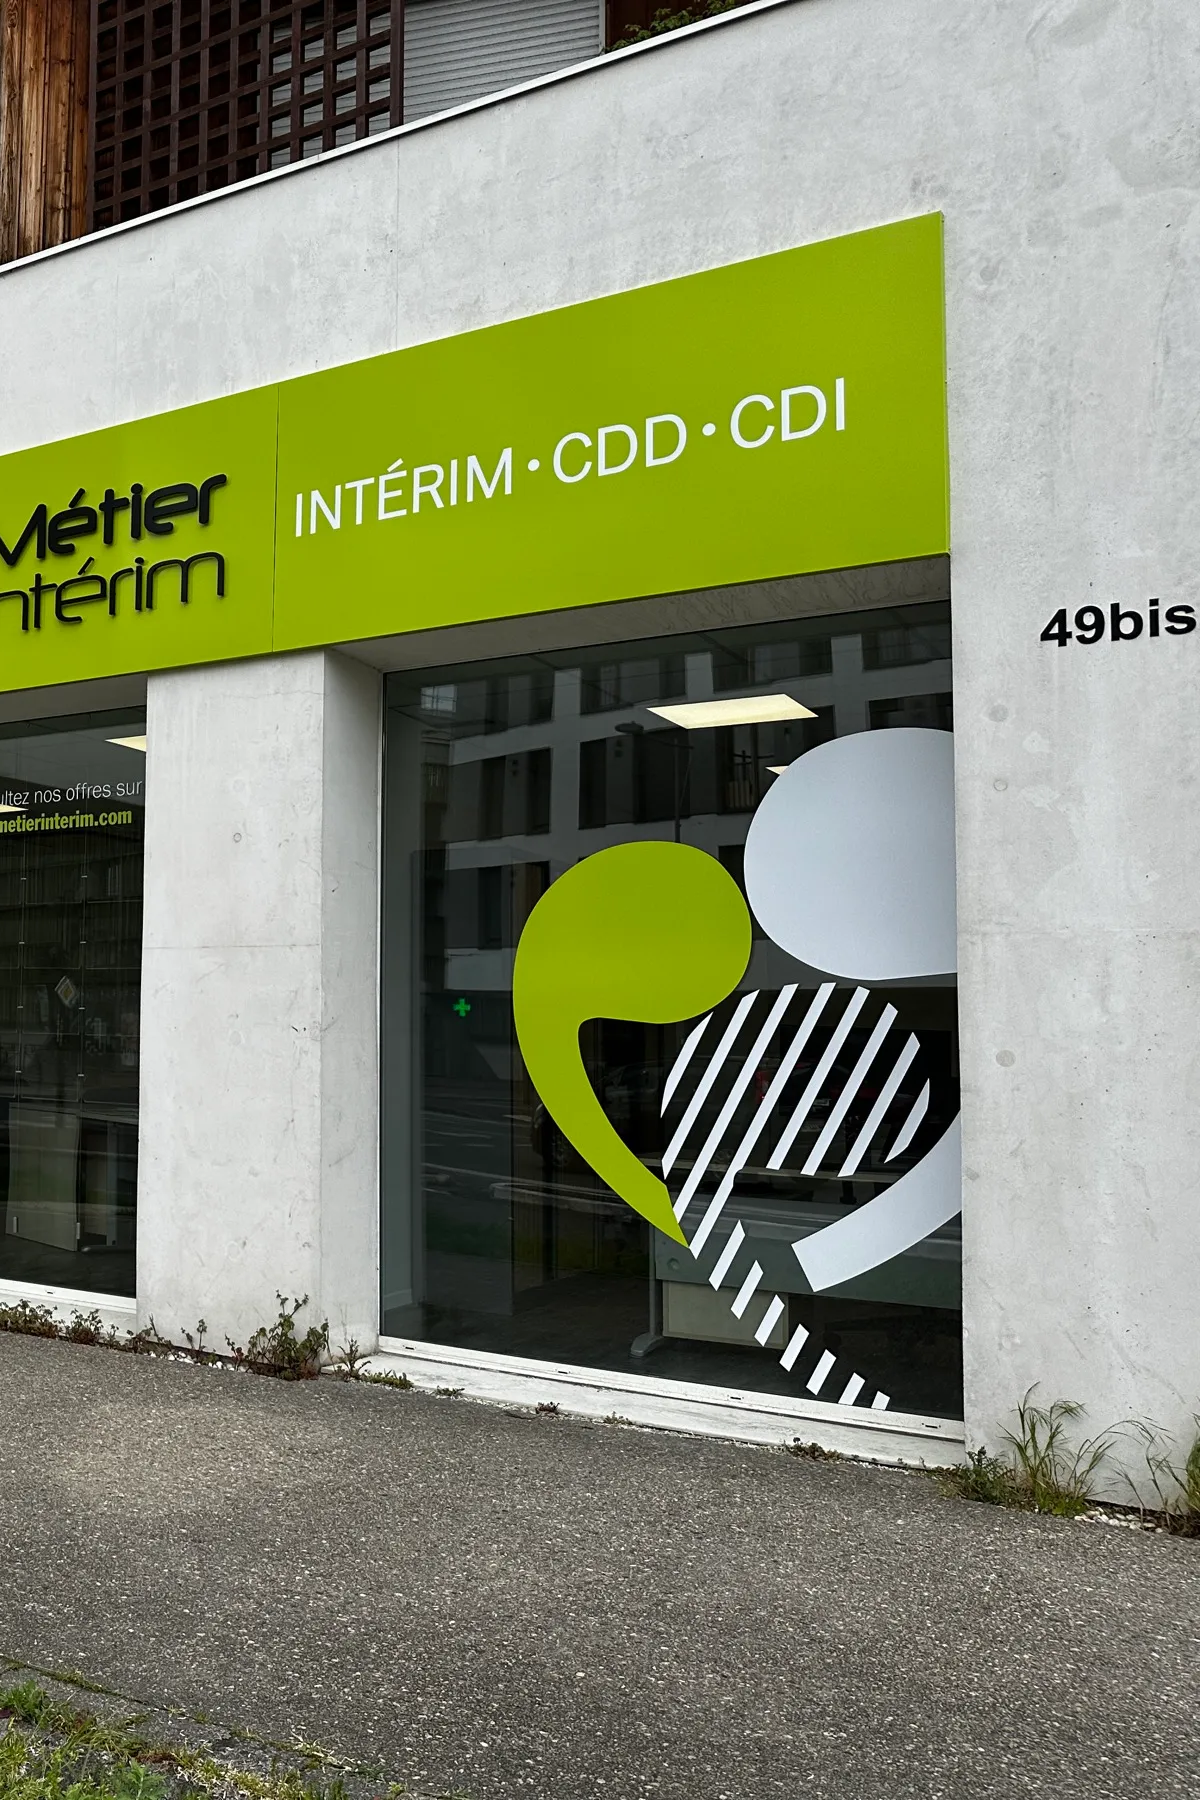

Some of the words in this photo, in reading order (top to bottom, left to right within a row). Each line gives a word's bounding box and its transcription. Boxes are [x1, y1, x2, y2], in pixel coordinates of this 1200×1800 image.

[294, 459, 513, 538] INTÉRIM
[553, 413, 688, 485] CDD
[730, 377, 846, 449] CDI
[1039, 597, 1197, 648] 49bis
[34, 788, 62, 804] nos
[65, 782, 112, 802] offres
[116, 780, 143, 797] sur
